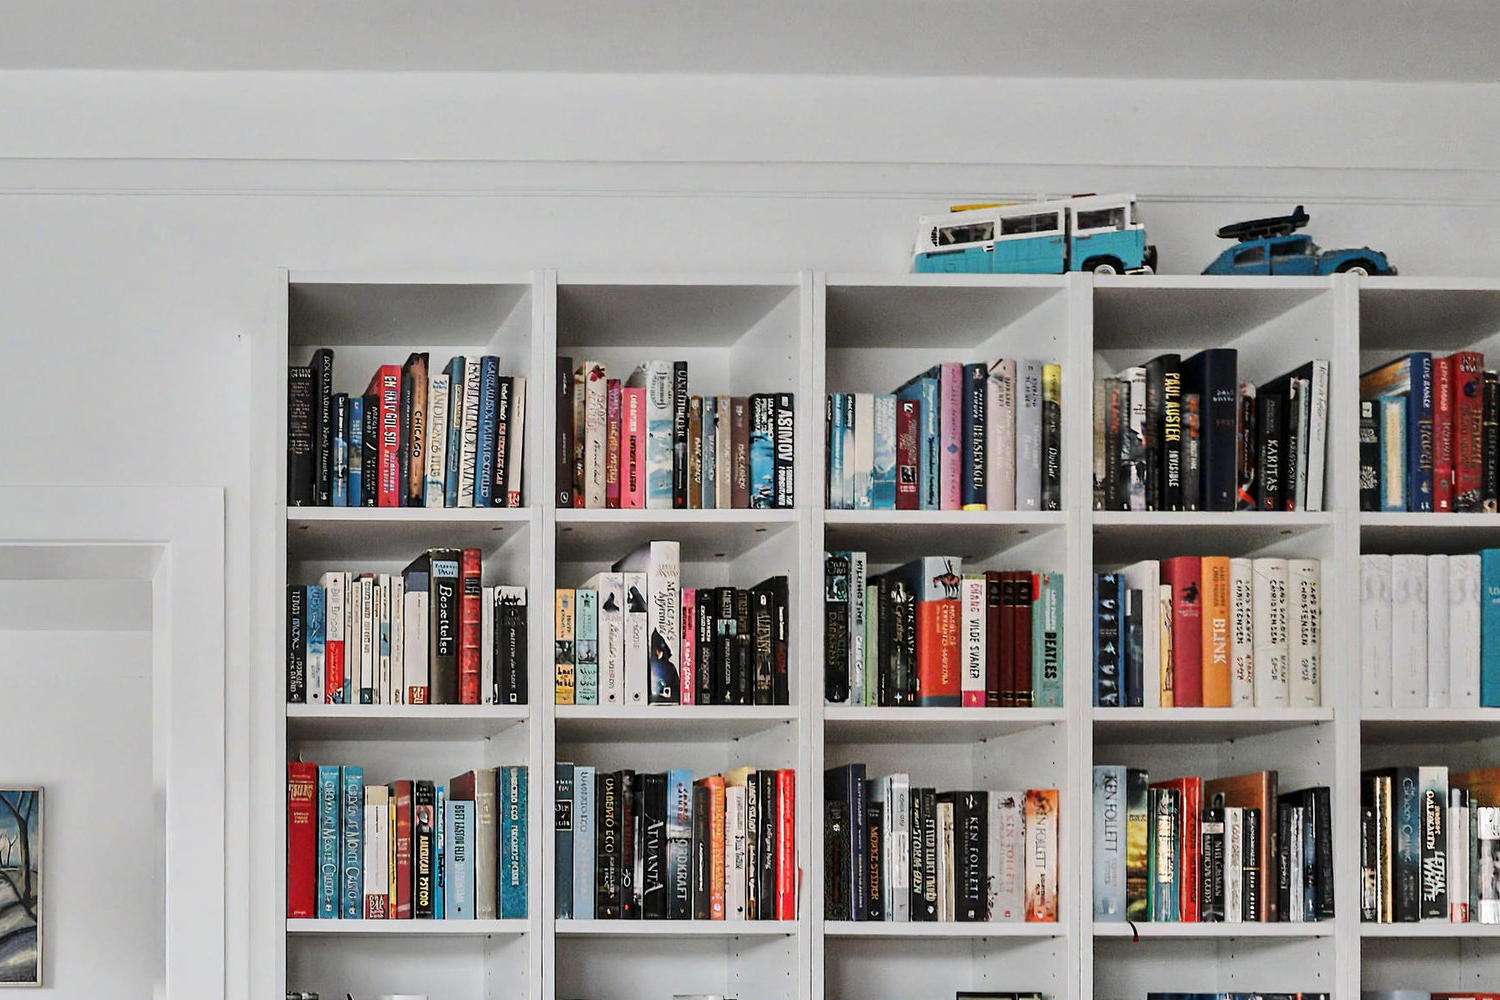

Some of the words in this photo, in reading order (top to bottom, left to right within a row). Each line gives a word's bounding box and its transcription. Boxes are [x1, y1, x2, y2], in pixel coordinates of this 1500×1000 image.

[1165, 372, 1180, 398] PAUL
[413, 411, 422, 458] CHICAGO
[778, 409, 792, 461] ASIMOV
[1165, 401, 1180, 442] AUSTER
[1266, 440, 1278, 491] KARITAS
[970, 620, 979, 642] VILDE
[1212, 618, 1226, 664] BLINK
[1045, 632, 1056, 679] BEATLES
[1105, 775, 1116, 800] KEN
[970, 817, 978, 839] KEN
[1035, 827, 1046, 868] FOLLETT
[1105, 804, 1117, 853] FOLLETT
[970, 848, 978, 900] FOLLETT
[1424, 858, 1435, 902] WHITE
[1433, 850, 1444, 895] LETHAL
